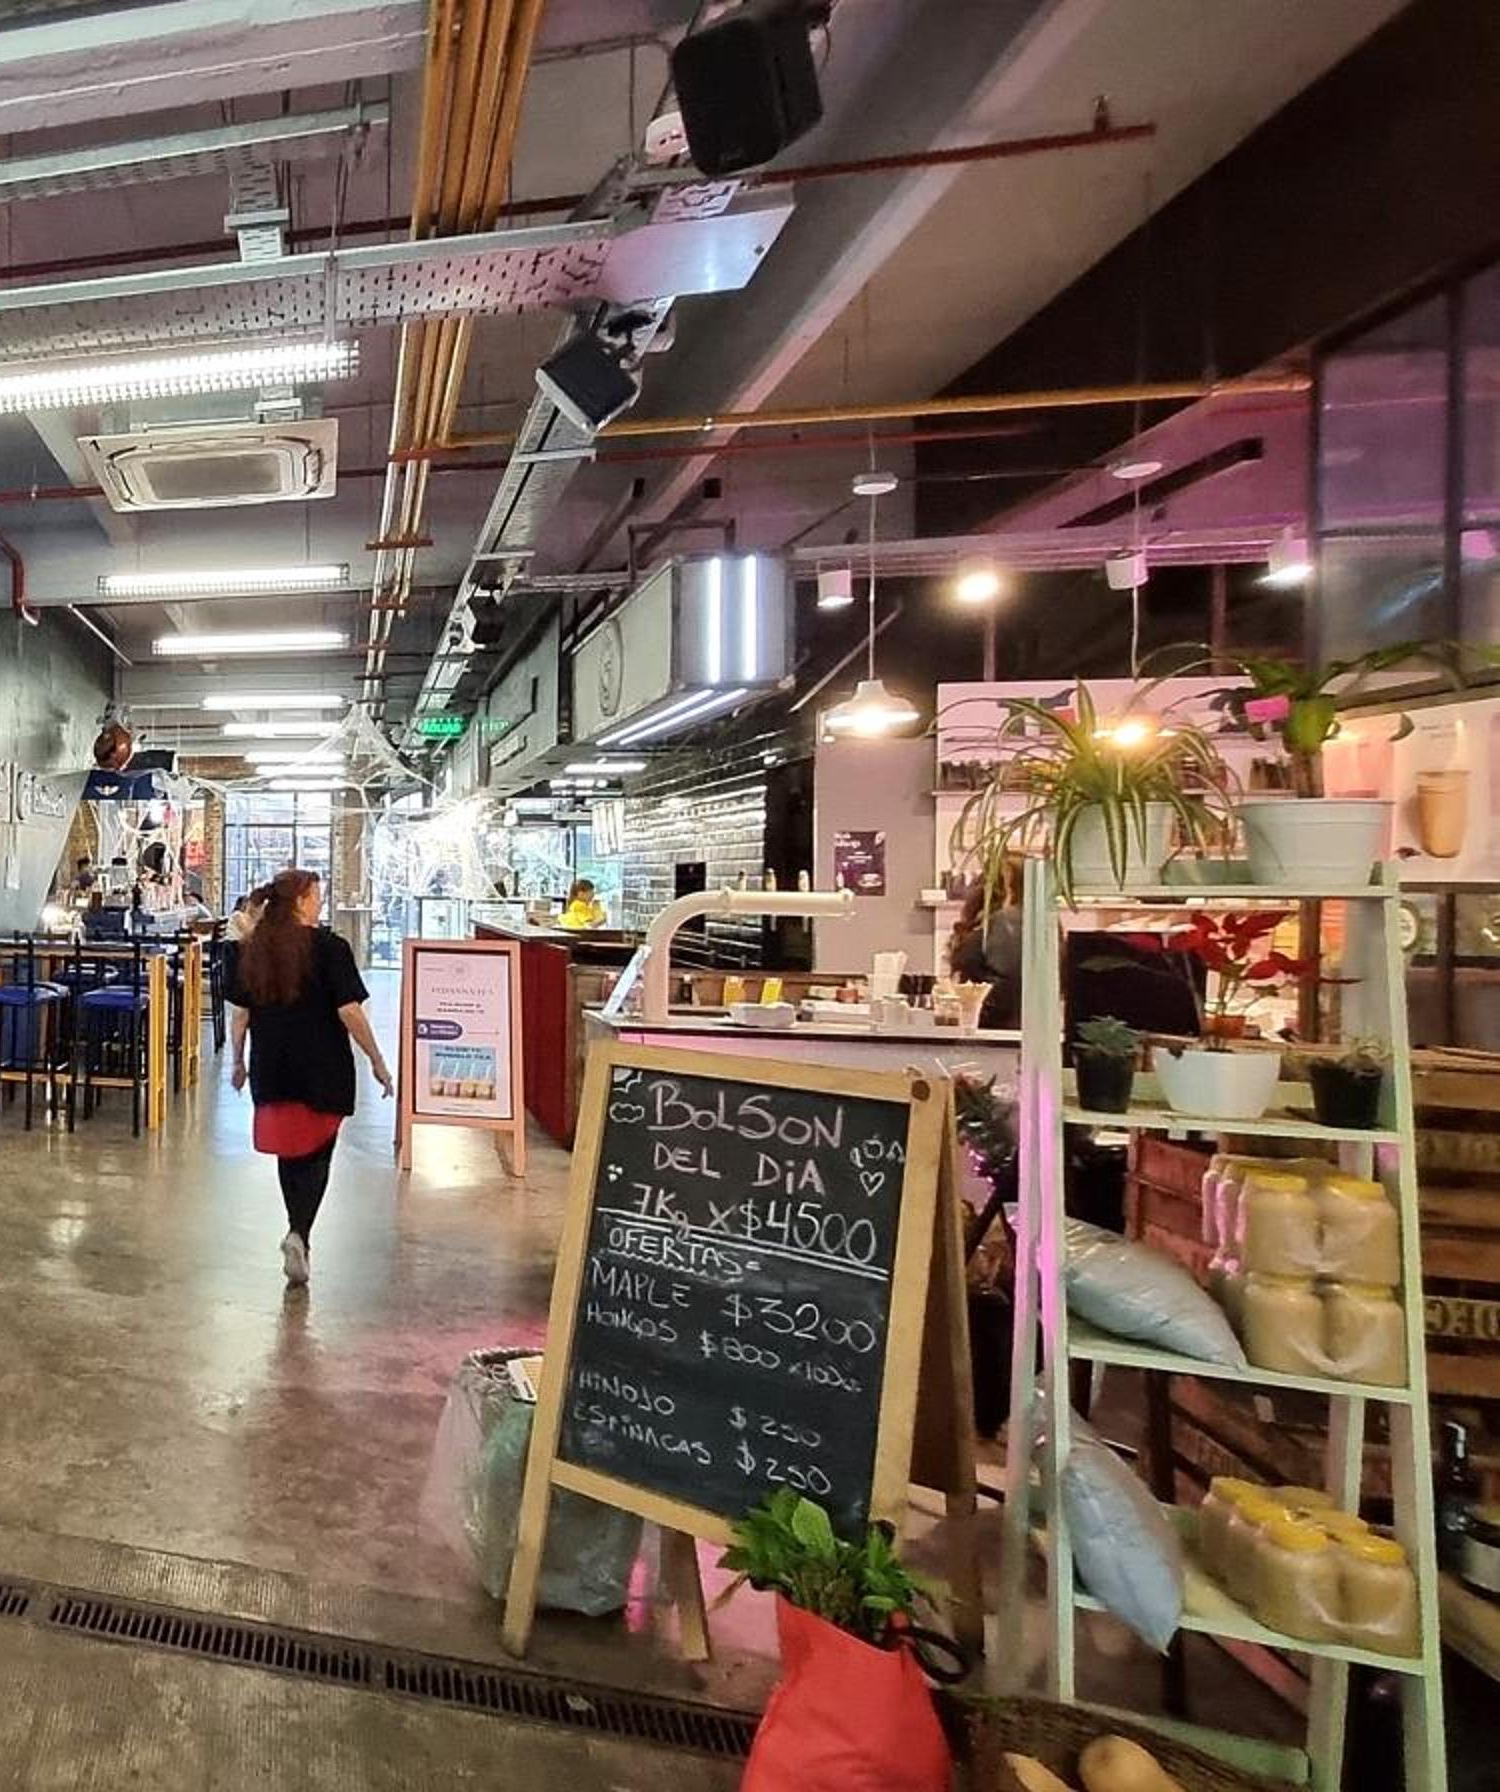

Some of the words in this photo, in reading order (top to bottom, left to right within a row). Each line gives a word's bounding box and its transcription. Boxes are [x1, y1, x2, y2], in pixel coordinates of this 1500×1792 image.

[653, 1141, 721, 1179] DEL
[591, 1256, 691, 1308] MAPLE
[586, 1302, 678, 1344] HONGOS
